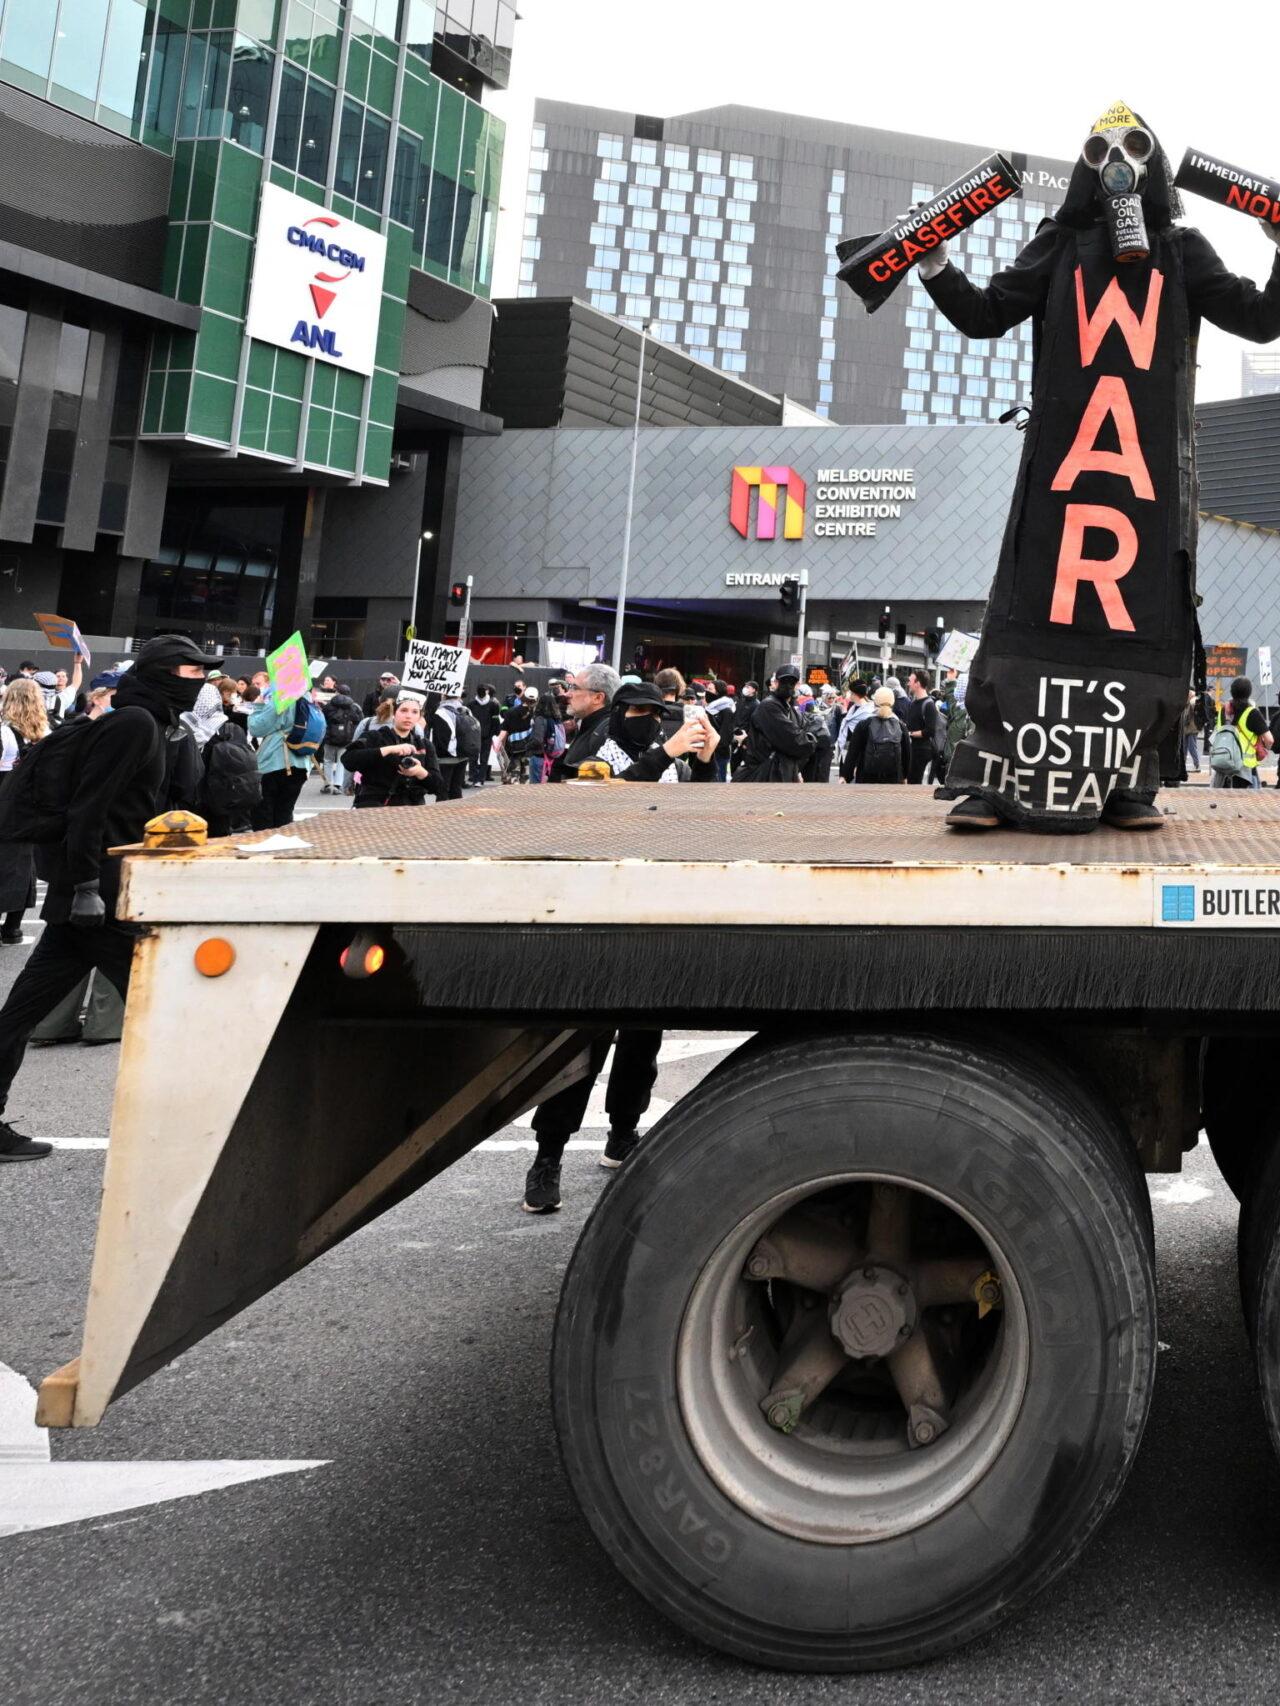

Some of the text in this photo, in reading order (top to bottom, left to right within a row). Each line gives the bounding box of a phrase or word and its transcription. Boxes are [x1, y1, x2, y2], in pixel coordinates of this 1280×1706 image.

[1099, 114, 1131, 126] MORE
[1108, 105, 1125, 115] NO
[1021, 170, 1069, 190] N PAC
[1190, 155, 1270, 196] IMMEDIATE
[894, 167, 998, 241] UNCONDITIONAL
[1112, 198, 1142, 209] COAL
[1118, 208, 1136, 217] OIL
[868, 175, 1013, 283] CEASEFIRE
[1116, 217, 1139, 228] GAS
[287, 226, 366, 272] CMA CGM
[290, 320, 343, 358] ANL
[817, 468, 915, 483] MELBOURNE
[816, 486, 916, 501] CONVENTION
[815, 504, 901, 519] EXHIBITION
[814, 522, 877, 537] CENTRE
[1038, 677, 1126, 722] IT'S
[1003, 721, 1142, 769] OSTIN
[978, 751, 1142, 812] THE EAH
[1202, 888, 1280, 916] BUTLER
[623, 1386, 732, 1564] GAR827
